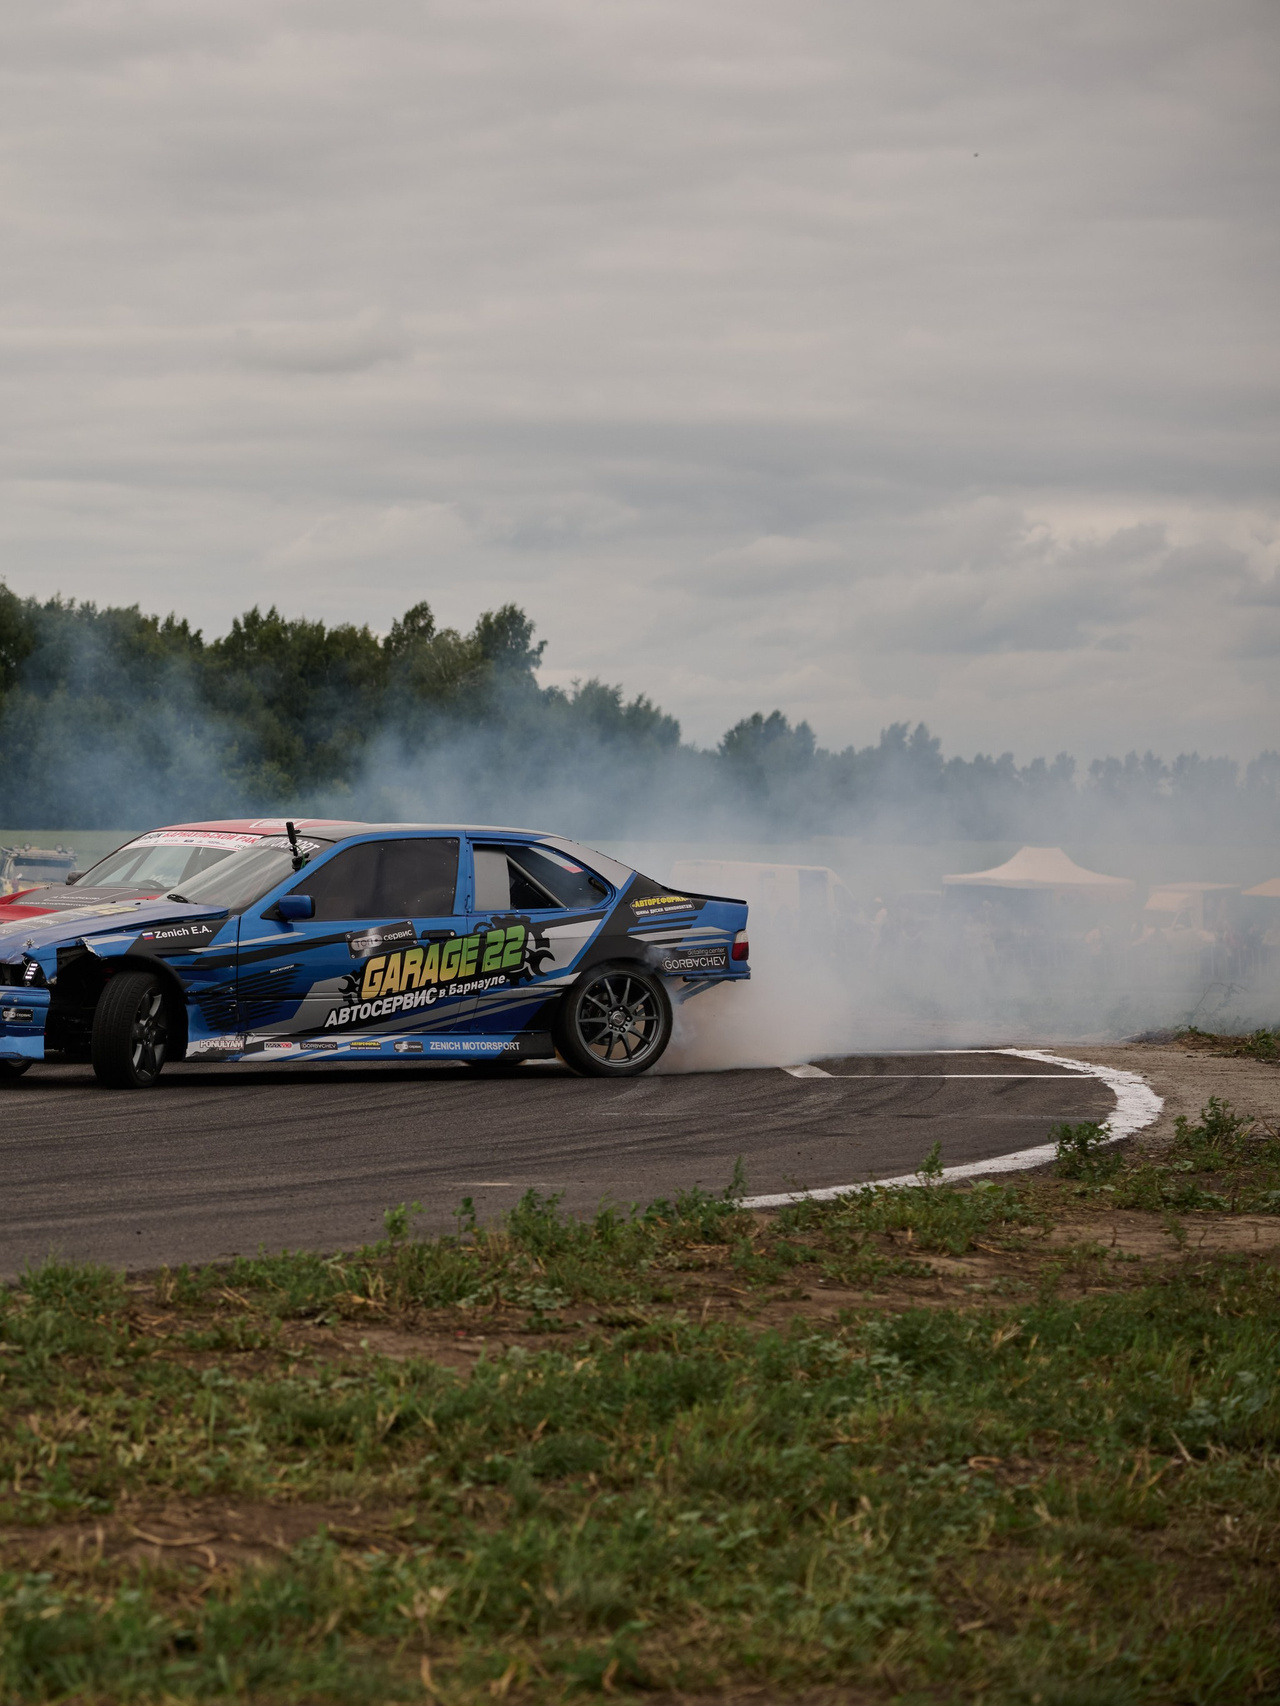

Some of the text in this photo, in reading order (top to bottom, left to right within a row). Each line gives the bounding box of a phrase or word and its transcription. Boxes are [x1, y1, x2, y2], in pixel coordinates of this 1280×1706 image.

[154, 925, 212, 939] Zenich E.A.
[355, 929, 413, 948] ТОП сервис
[360, 924, 526, 1000] GARAGE 22
[324, 974, 506, 1028] АВТОСЕРВИС в Барнауле
[200, 1040, 243, 1048] PONULYAM
[430, 1041, 520, 1050] ZENICH MOTORSPORT
